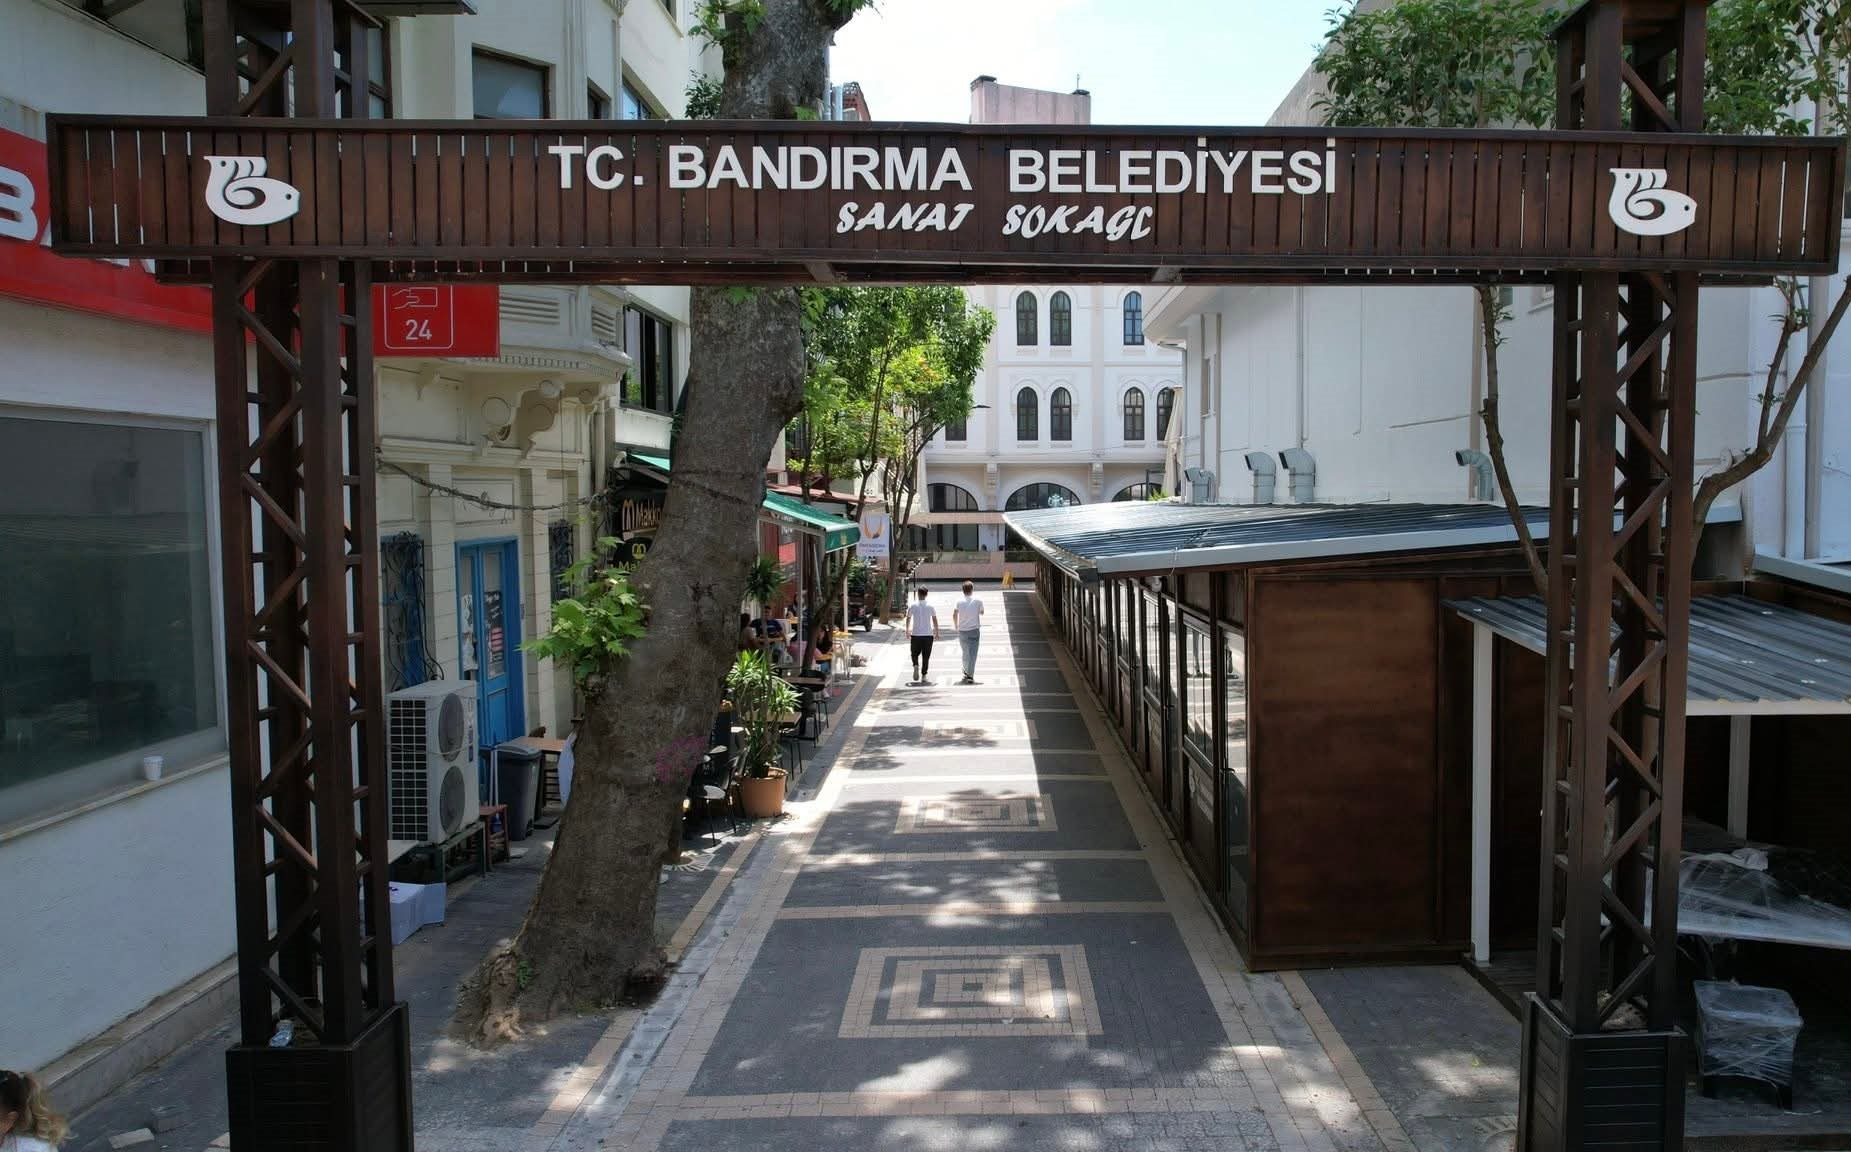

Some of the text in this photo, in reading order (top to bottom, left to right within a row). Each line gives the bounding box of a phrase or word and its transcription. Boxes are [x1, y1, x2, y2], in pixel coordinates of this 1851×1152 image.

[548, 137, 1336, 195] TC. BANDIRMA BELEDİYESİ
[836, 201, 975, 233] SANAT
[405, 319, 432, 340] 24
